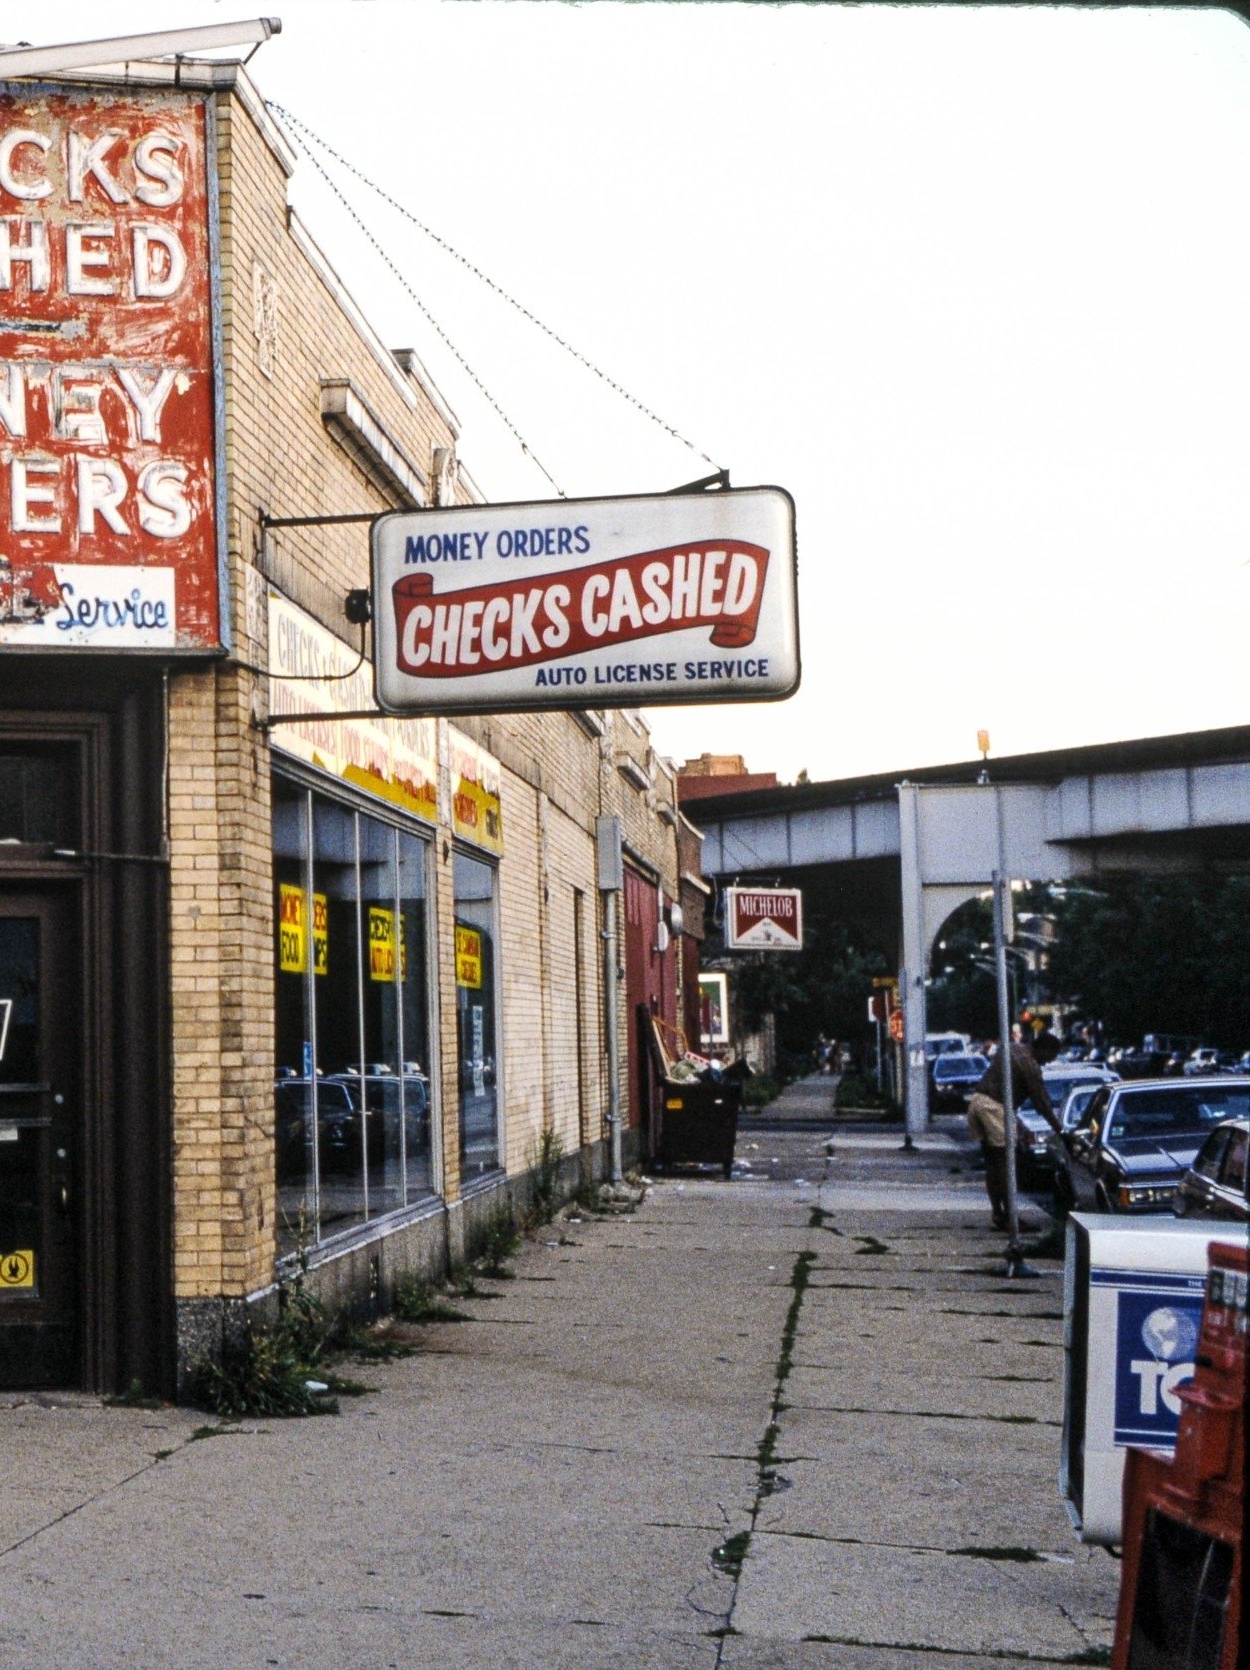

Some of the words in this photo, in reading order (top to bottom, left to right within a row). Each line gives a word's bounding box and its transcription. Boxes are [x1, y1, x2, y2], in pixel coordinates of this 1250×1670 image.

[403, 531, 491, 565] MONEY
[496, 525, 591, 559] ORDERS
[57, 582, 169, 631] Service
[402, 589, 570, 666] CHECKS
[581, 551, 758, 638] CASHED
[535, 666, 588, 687] AUTO
[594, 663, 677, 684] LICENSE
[684, 659, 769, 681] SERVICE
[739, 895, 793, 917] MICHELOB
